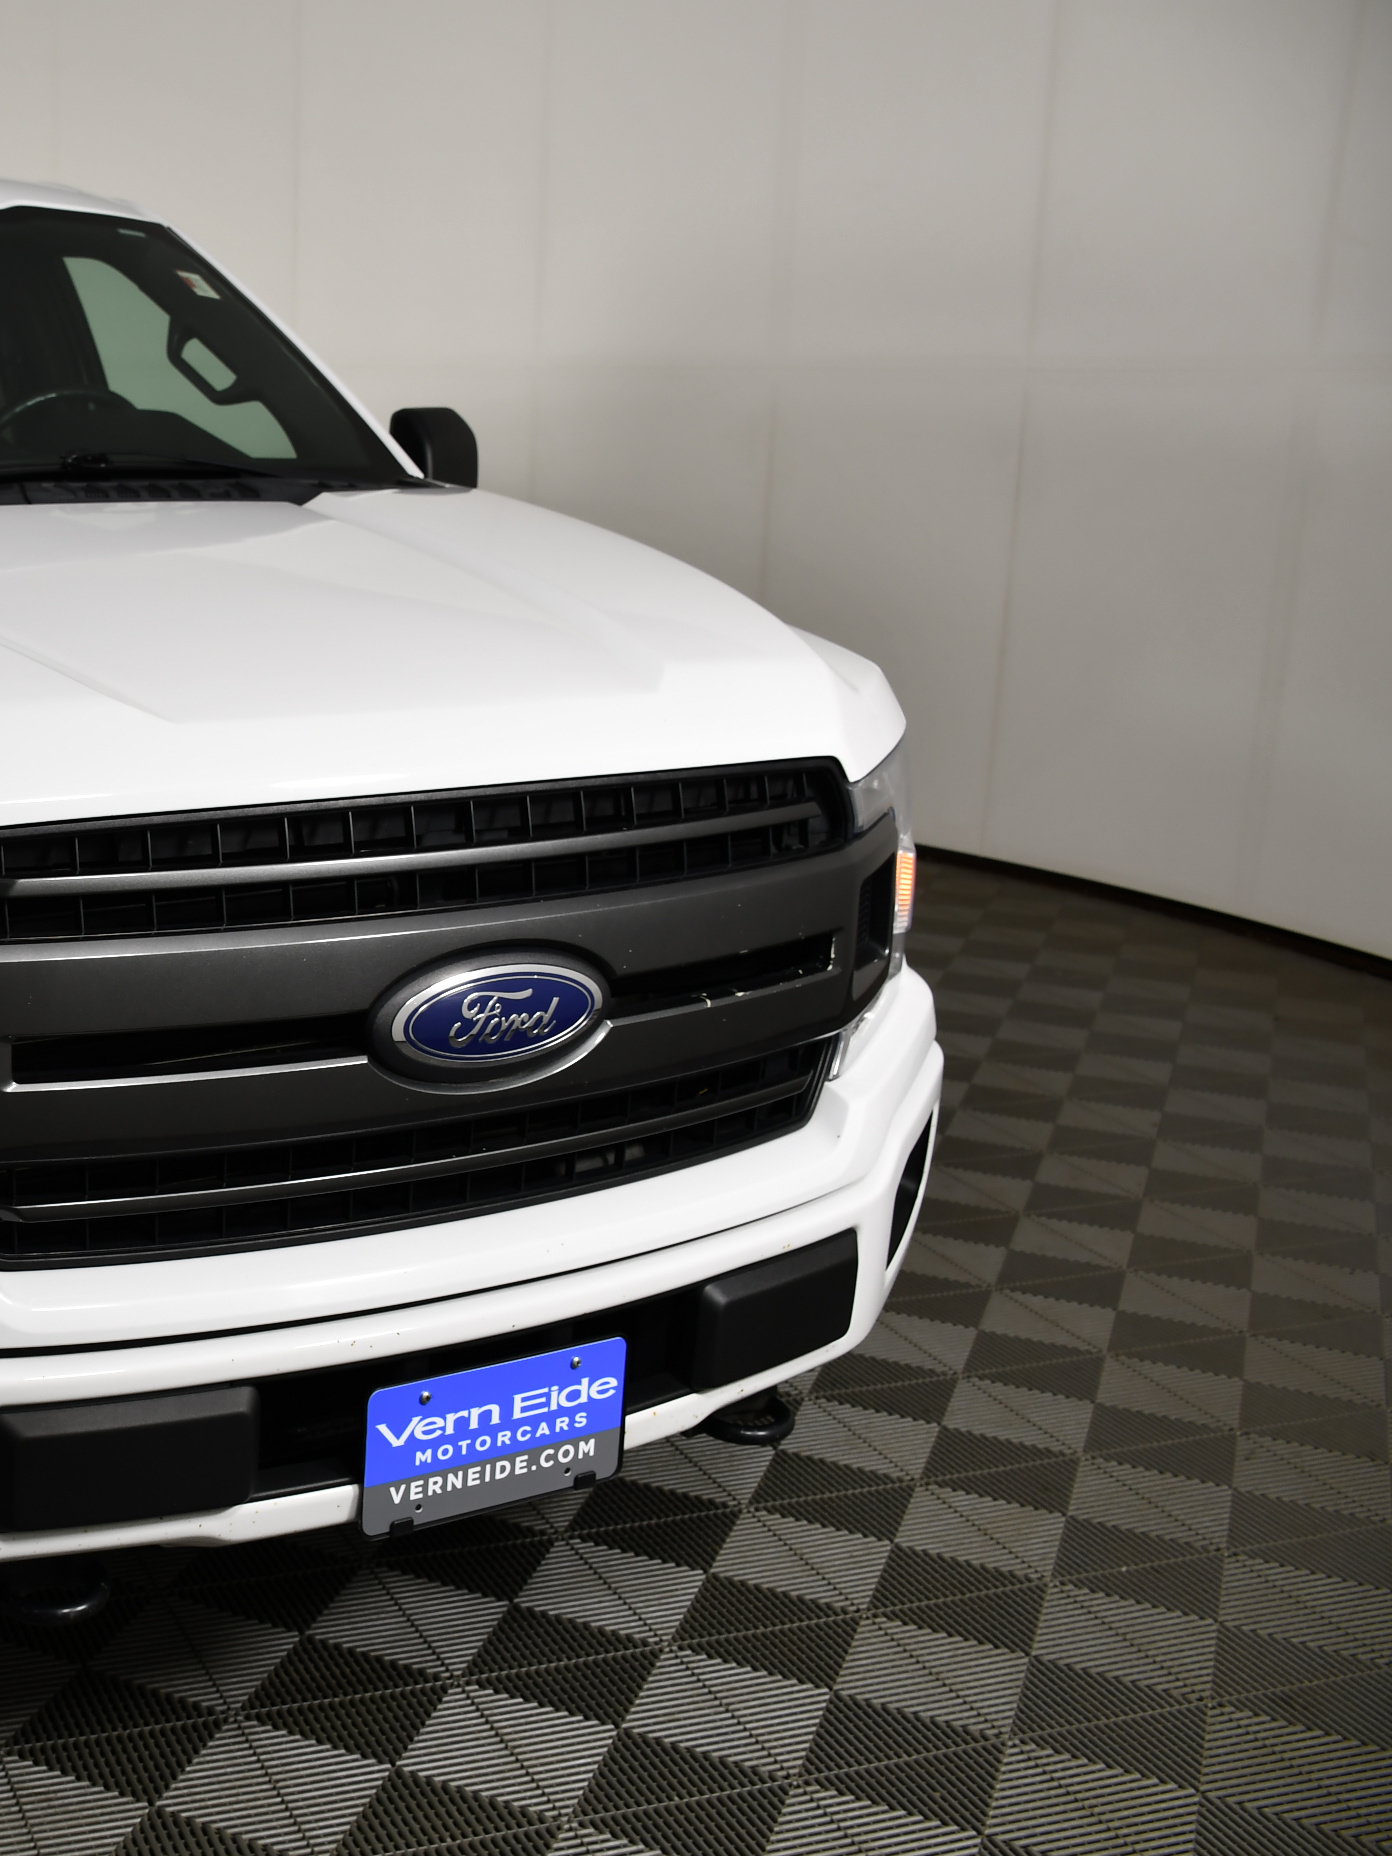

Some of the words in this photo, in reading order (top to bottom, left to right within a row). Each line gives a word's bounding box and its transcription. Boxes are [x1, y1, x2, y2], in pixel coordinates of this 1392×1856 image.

[449, 988, 560, 1047] Ford
[376, 1403, 501, 1447] Vern
[512, 1376, 618, 1420] Eide
[415, 1412, 588, 1466] MOTORCARS
[389, 1438, 596, 1504] VERNEIDE.COM
